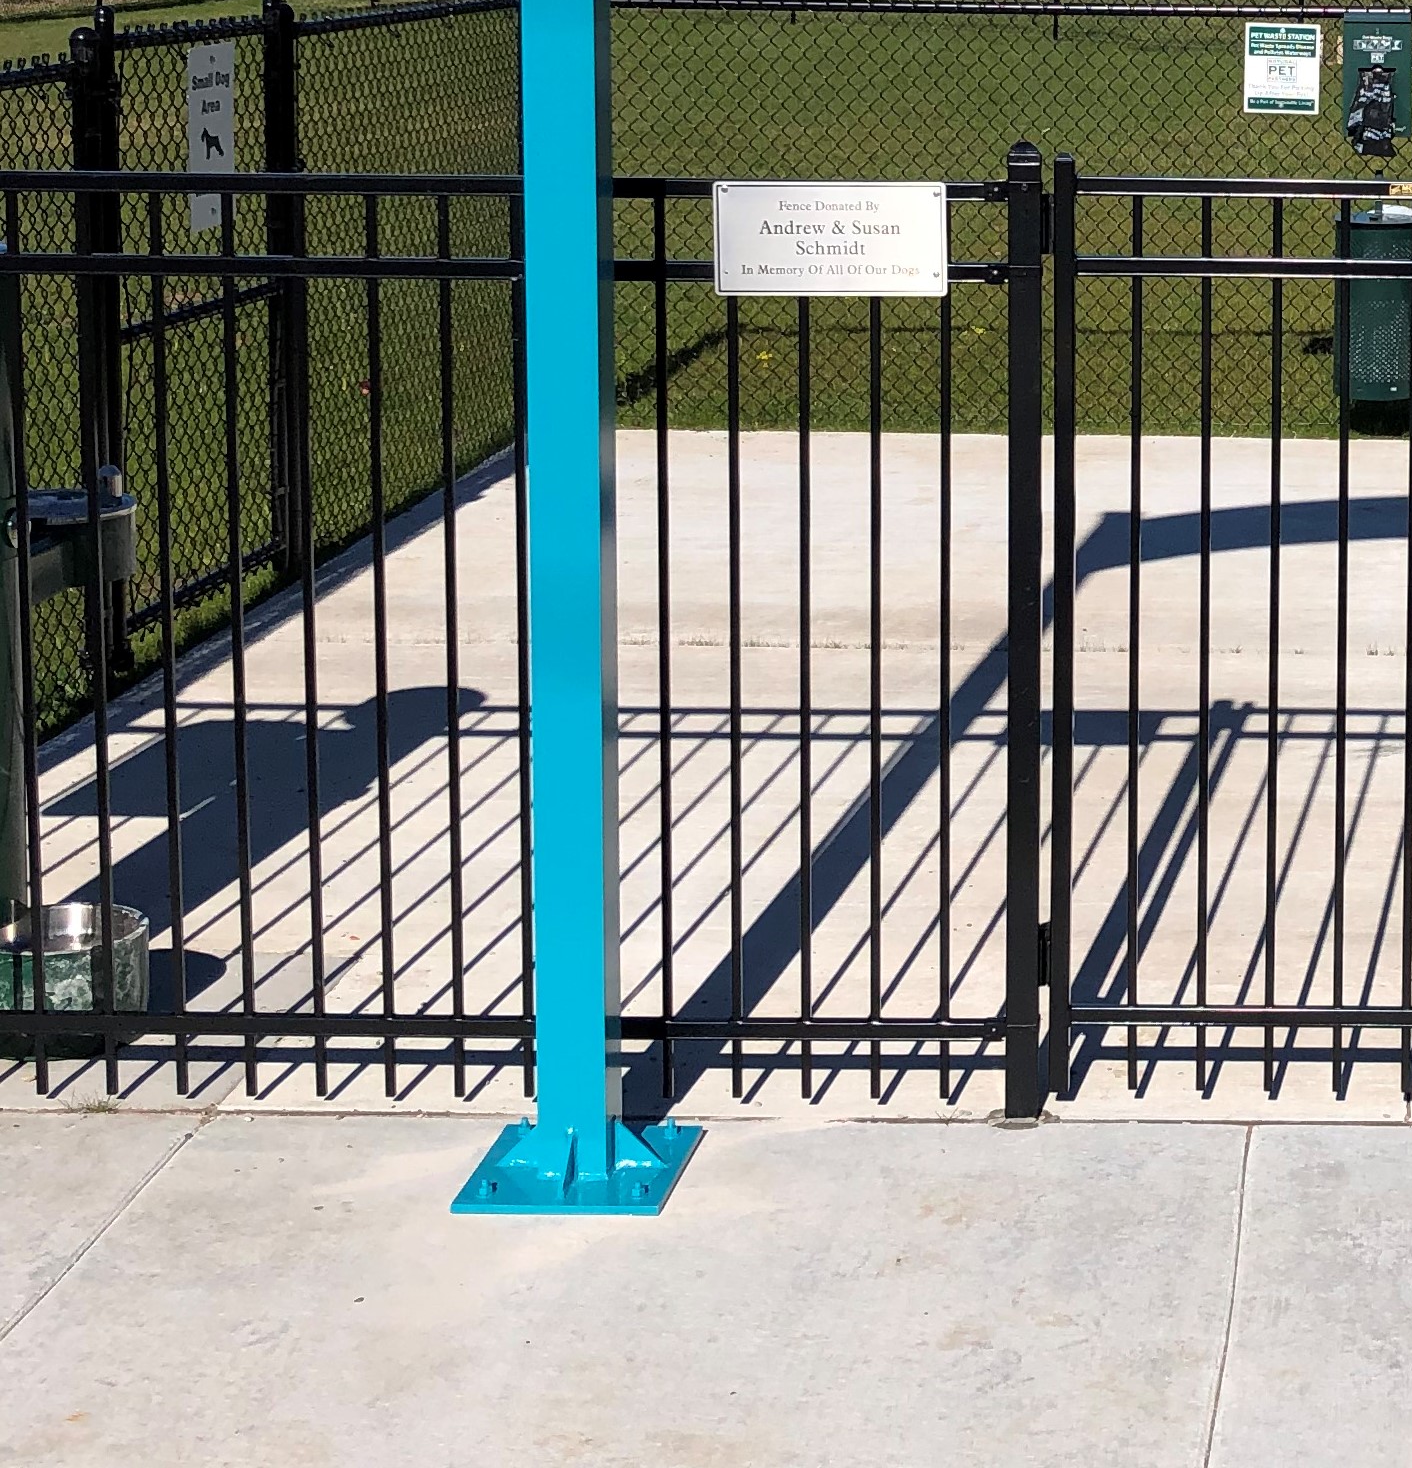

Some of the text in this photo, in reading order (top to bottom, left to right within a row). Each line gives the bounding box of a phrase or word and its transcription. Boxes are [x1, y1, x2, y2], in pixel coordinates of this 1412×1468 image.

[1268, 65, 1295, 76] PET
[192, 72, 230, 90] Small Dog
[202, 100, 220, 115] Area
[778, 201, 879, 213] Fence Donated By
[759, 220, 900, 235] Andrew & Susan
[796, 241, 865, 255] Schmidt
[741, 265, 920, 277] In Memory Of All Of Our Dogs
